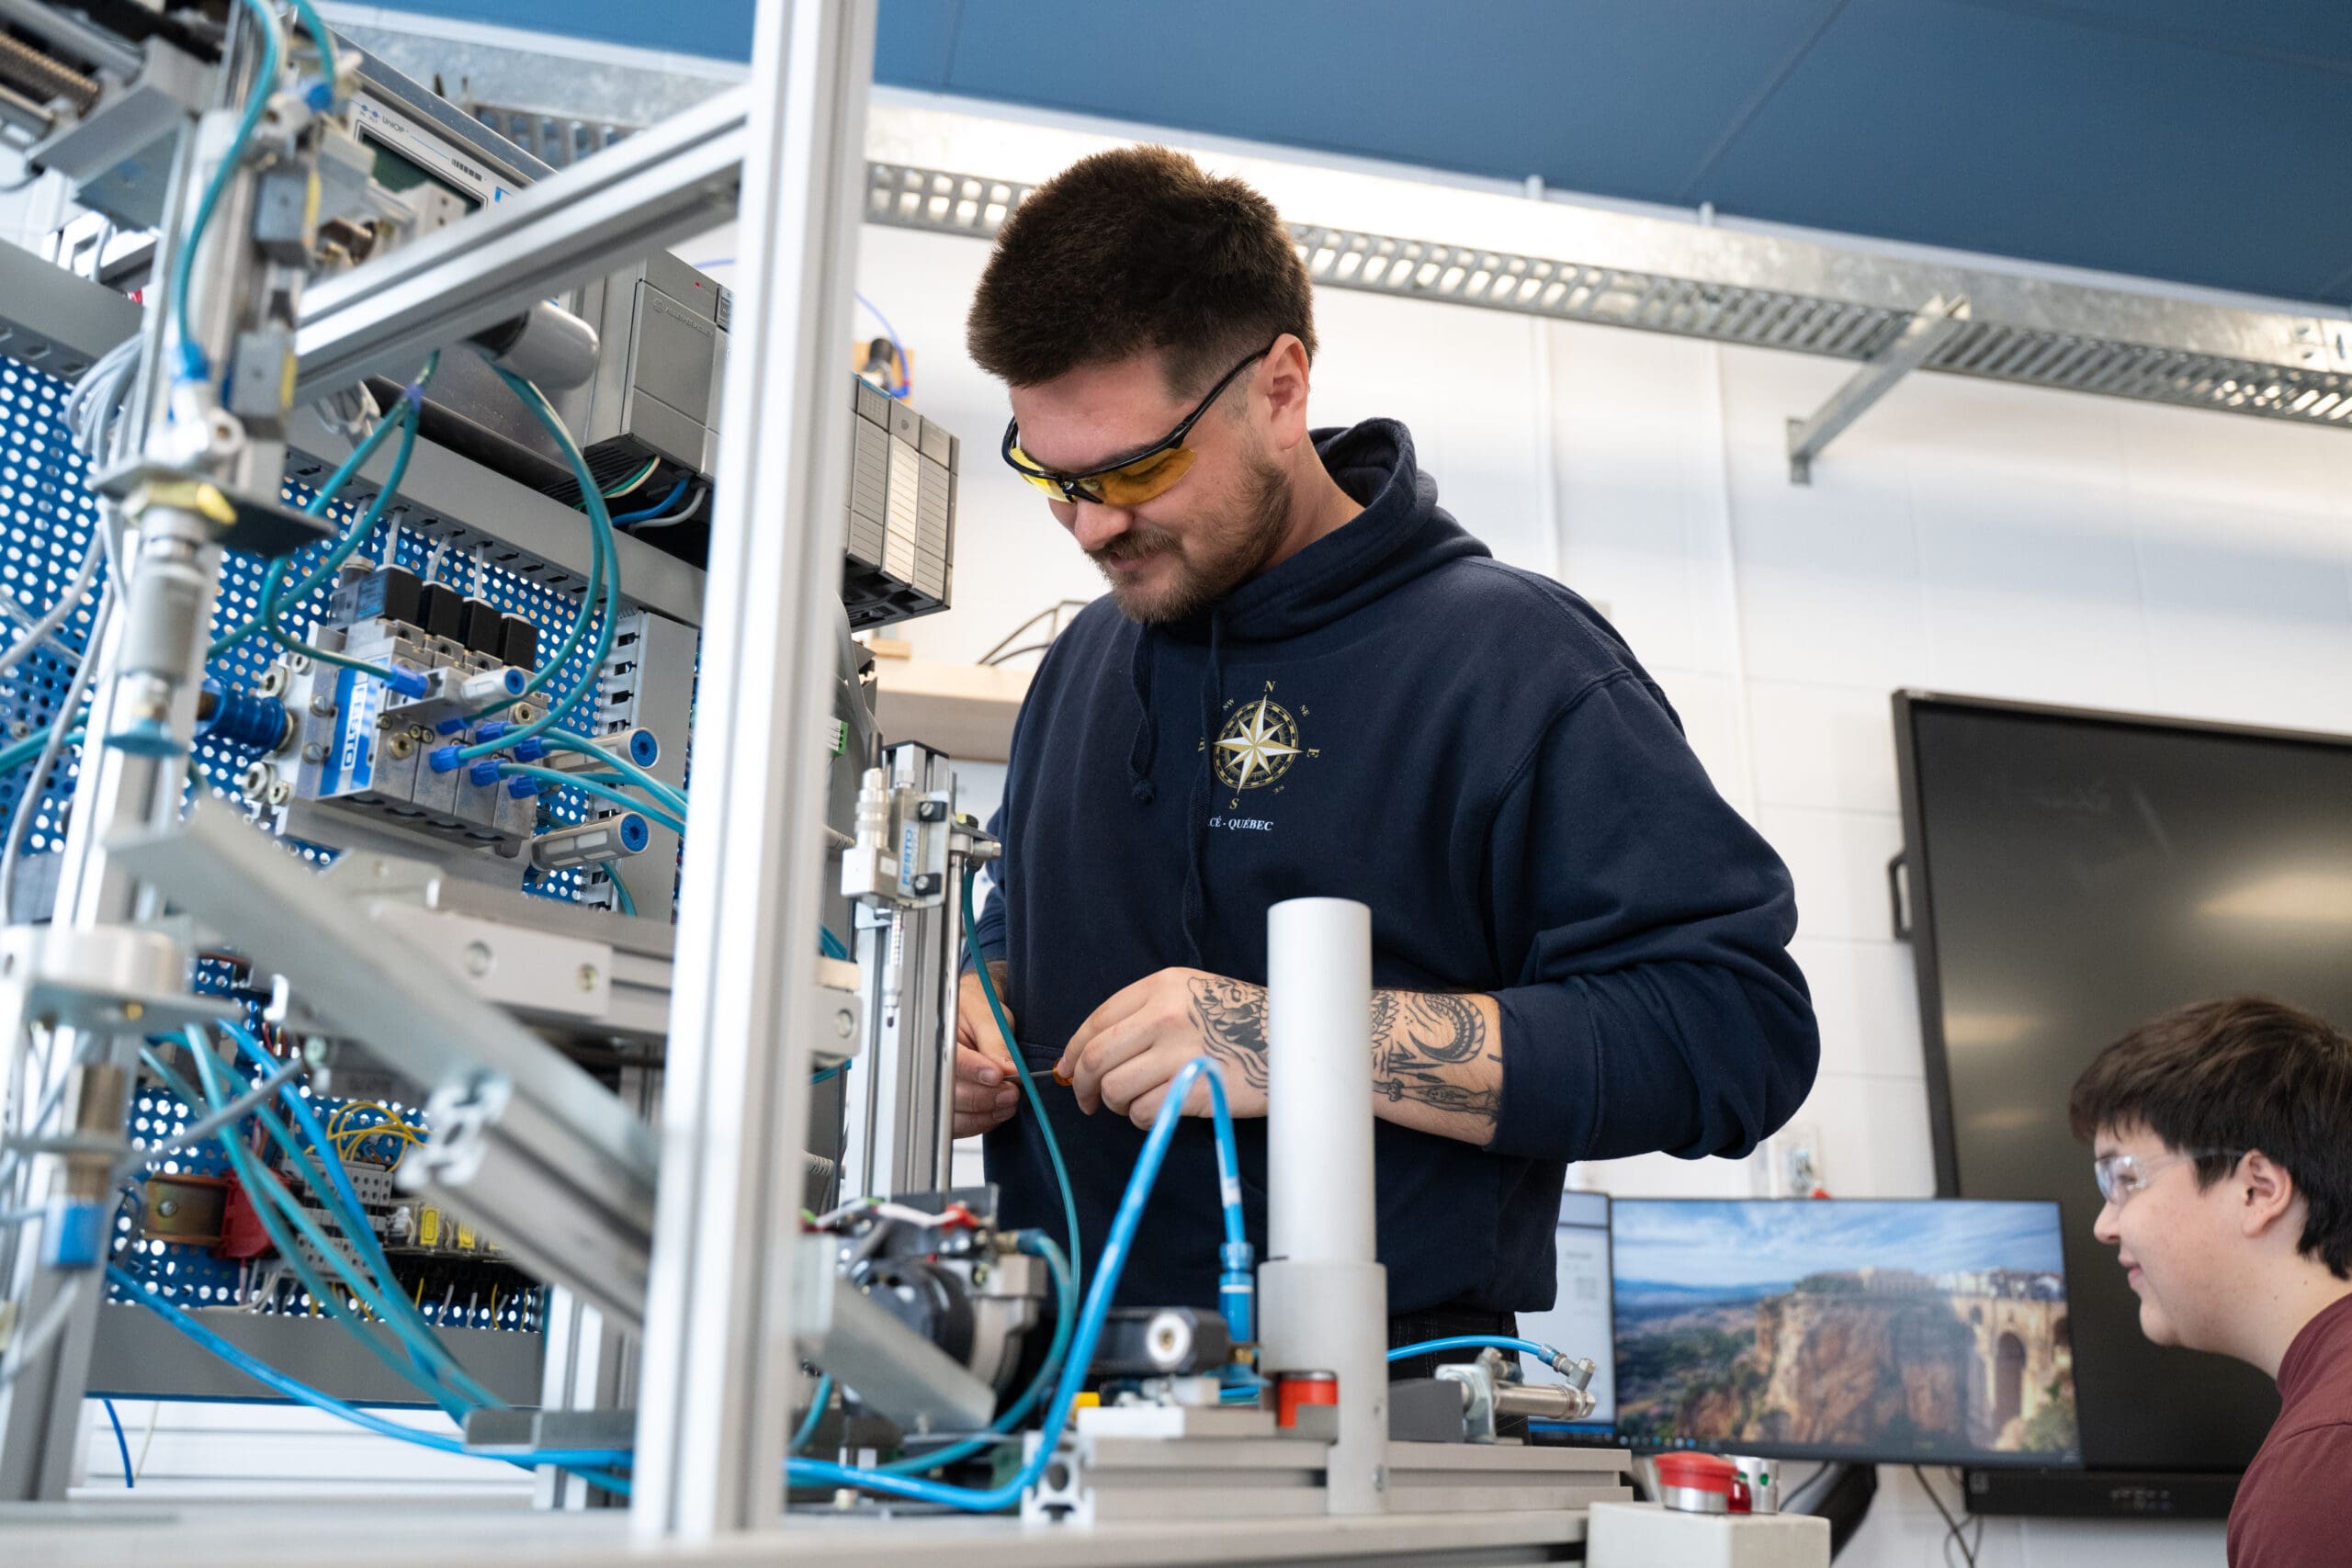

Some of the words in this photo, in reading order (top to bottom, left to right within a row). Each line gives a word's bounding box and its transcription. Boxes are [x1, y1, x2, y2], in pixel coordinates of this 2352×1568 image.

[1264, 681, 1275, 692] N
[344, 687, 365, 767] FESTO
[1306, 748, 1320, 758] E
[1229, 797, 1239, 809] S
[1208, 816, 1221, 828] CÉ
[1228, 818, 1273, 830] QUÉBEC
[902, 829, 913, 885] FESTO
